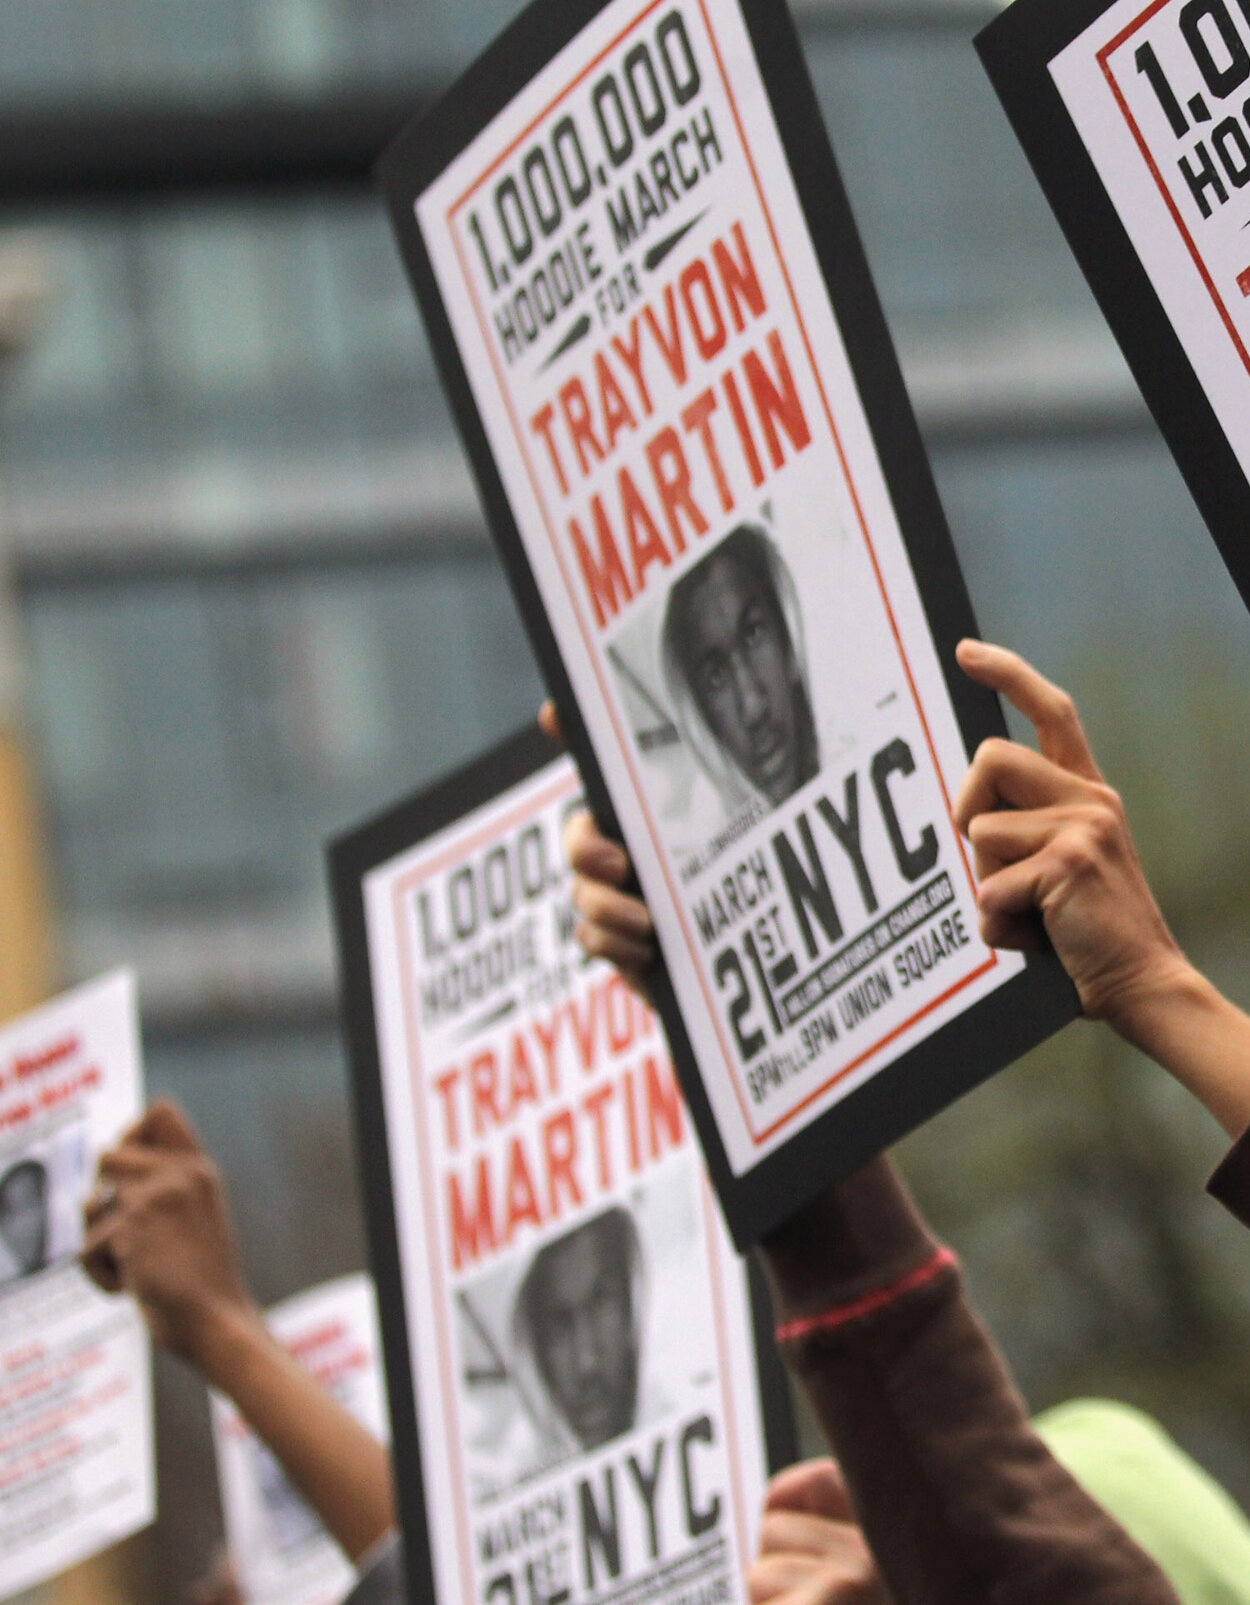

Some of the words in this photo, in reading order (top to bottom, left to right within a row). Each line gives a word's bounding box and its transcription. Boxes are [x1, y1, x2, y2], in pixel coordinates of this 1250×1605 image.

[491, 222, 602, 365] HOODIE
[604, 106, 725, 255] MARCH
[598, 262, 642, 330] FOR
[530, 220, 768, 498] TRAYVON
[566, 329, 812, 631] MARTIN
[692, 848, 775, 946] MARCH
[770, 737, 940, 962] NYC
[838, 967, 894, 1031] UNION
[893, 910, 970, 988] SQUARE
[447, 1057, 683, 1272] MARTIN
[577, 1414, 722, 1591] NYC
